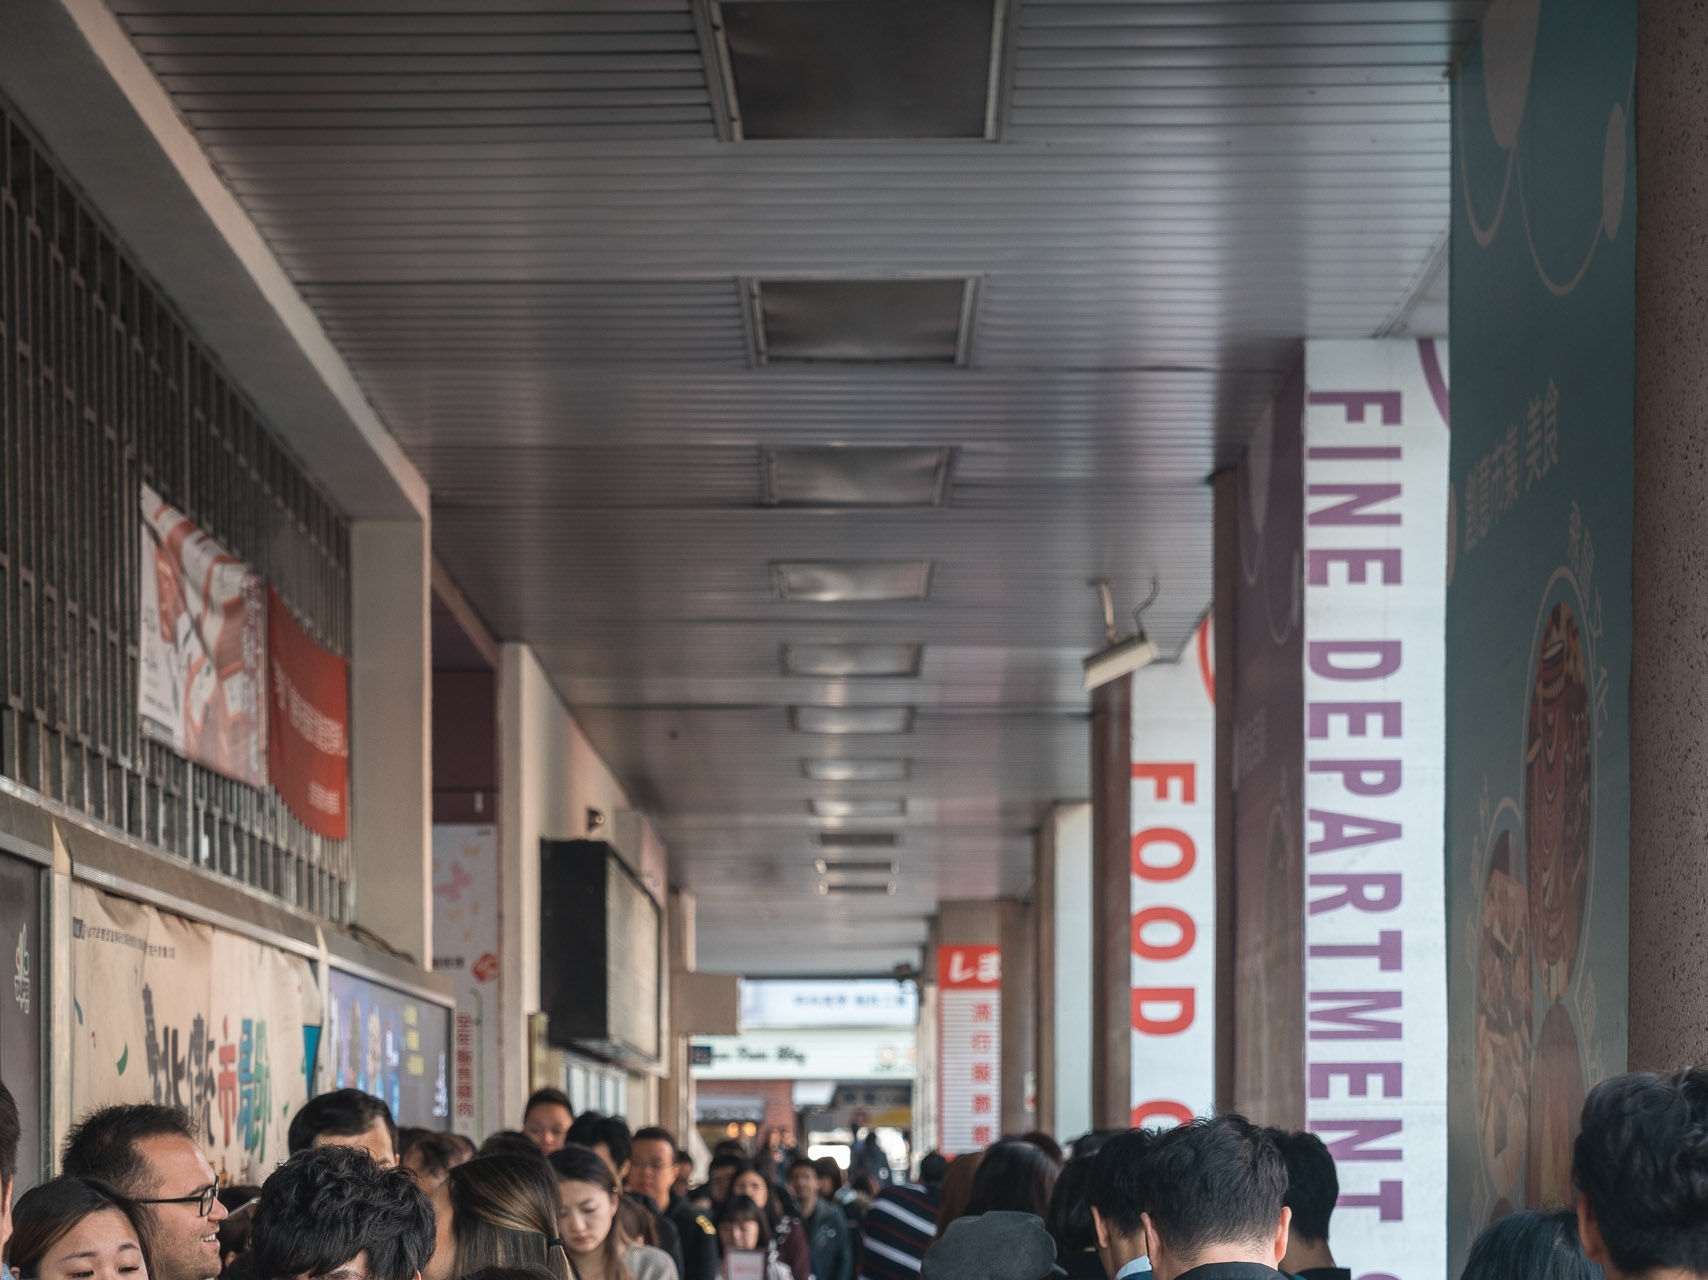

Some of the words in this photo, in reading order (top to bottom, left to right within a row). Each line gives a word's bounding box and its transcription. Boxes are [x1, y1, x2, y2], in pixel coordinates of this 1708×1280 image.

[1307, 391, 1402, 587] FINE
[1131, 762, 1197, 1037] FOOD
[1307, 640, 1402, 1223] DEPARTMENT
